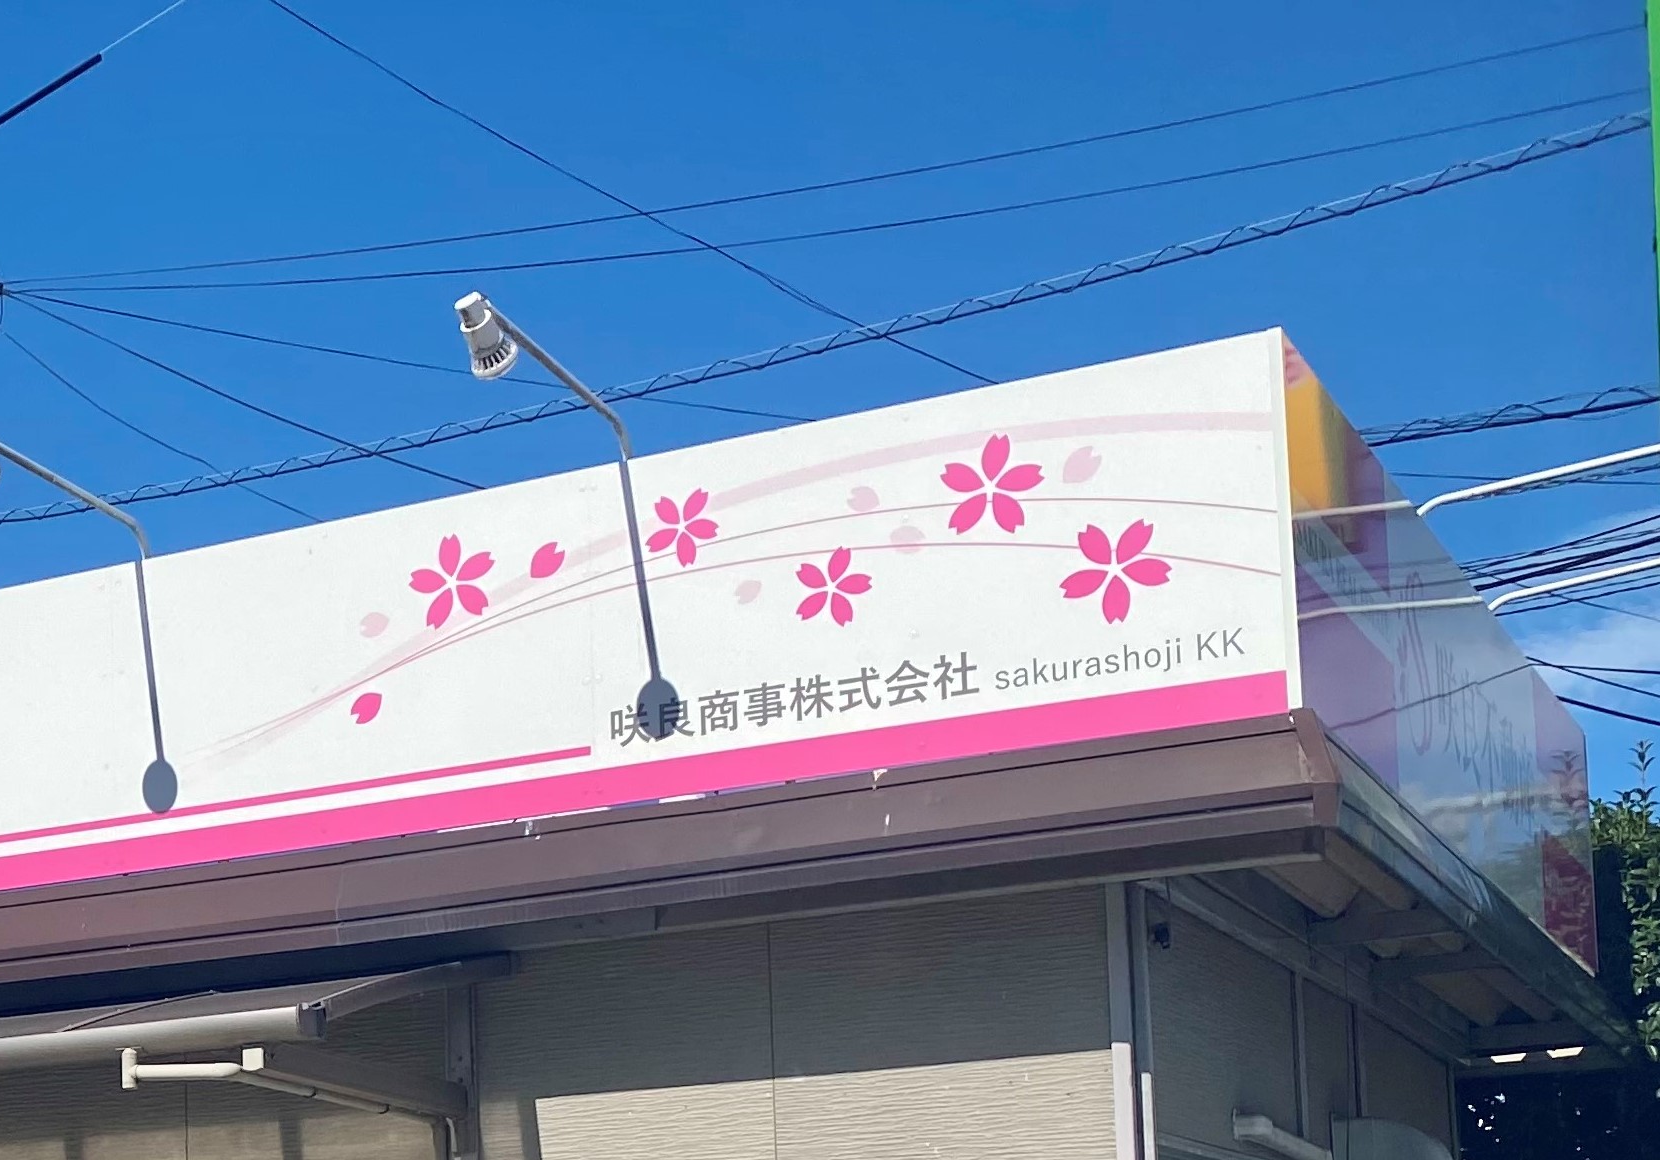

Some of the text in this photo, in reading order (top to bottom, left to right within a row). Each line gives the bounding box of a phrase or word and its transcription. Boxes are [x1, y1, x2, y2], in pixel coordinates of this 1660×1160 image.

[995, 627, 1245, 690] sakurashoji KK
[609, 652, 981, 747] 咲良商事株式会社
